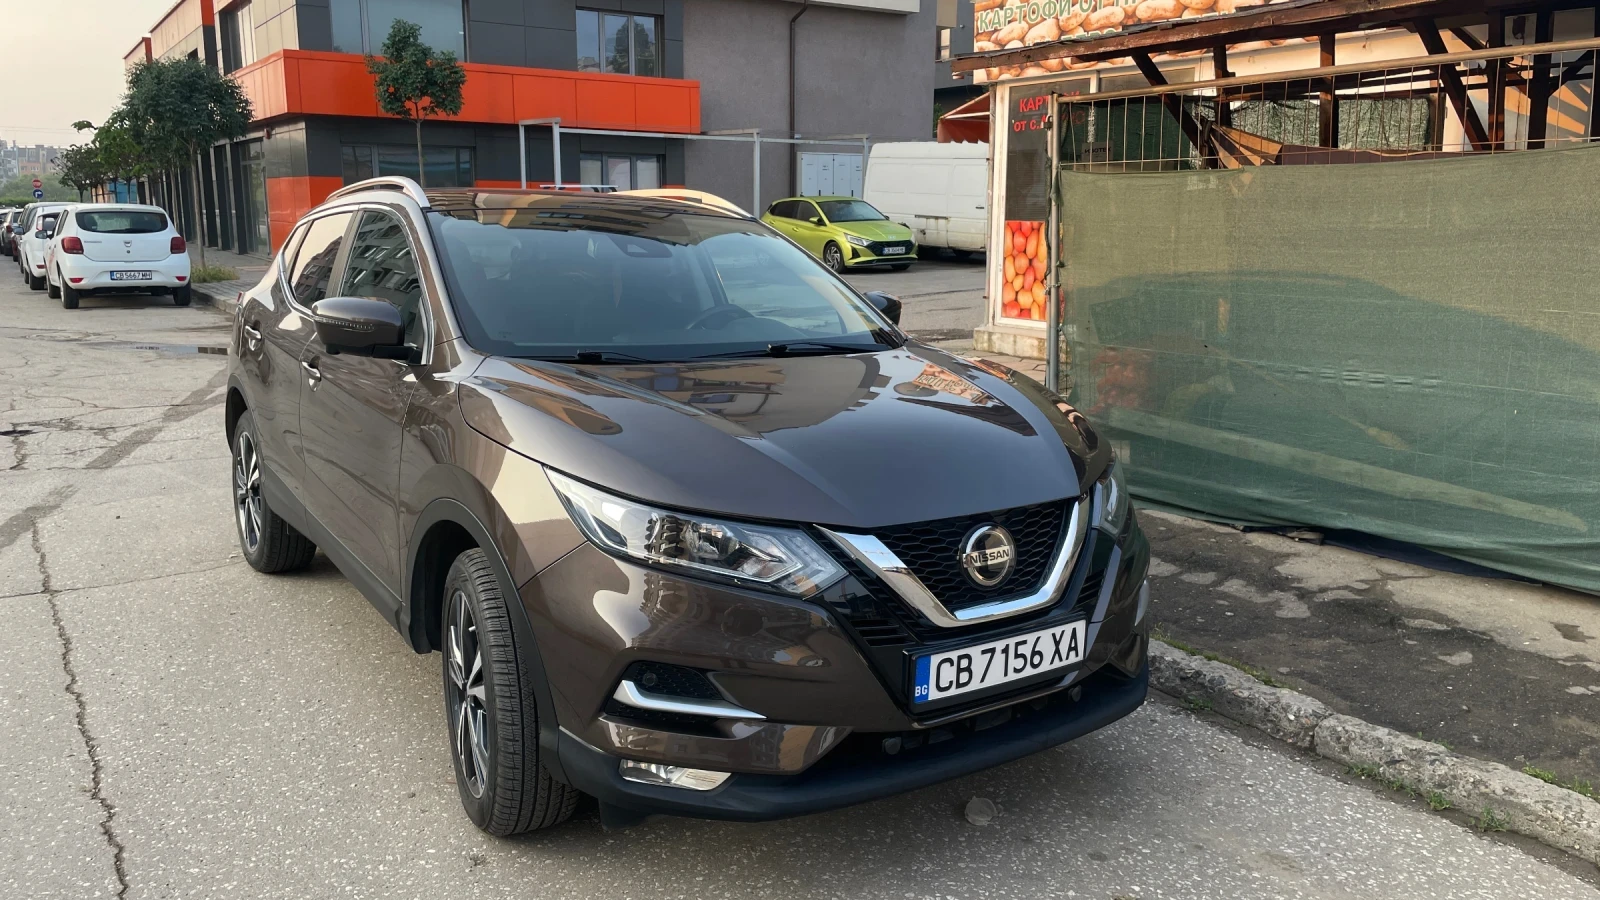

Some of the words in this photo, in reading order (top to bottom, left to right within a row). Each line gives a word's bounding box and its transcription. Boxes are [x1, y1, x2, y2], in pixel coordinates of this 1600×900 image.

[979, 0, 1071, 31] КАРТОФИ
[970, 549, 1010, 564] NISSAN
[935, 653, 973, 693] CB
[979, 636, 1044, 684] 7156
[1049, 627, 1079, 665] XA
[915, 684, 928, 697] BG
